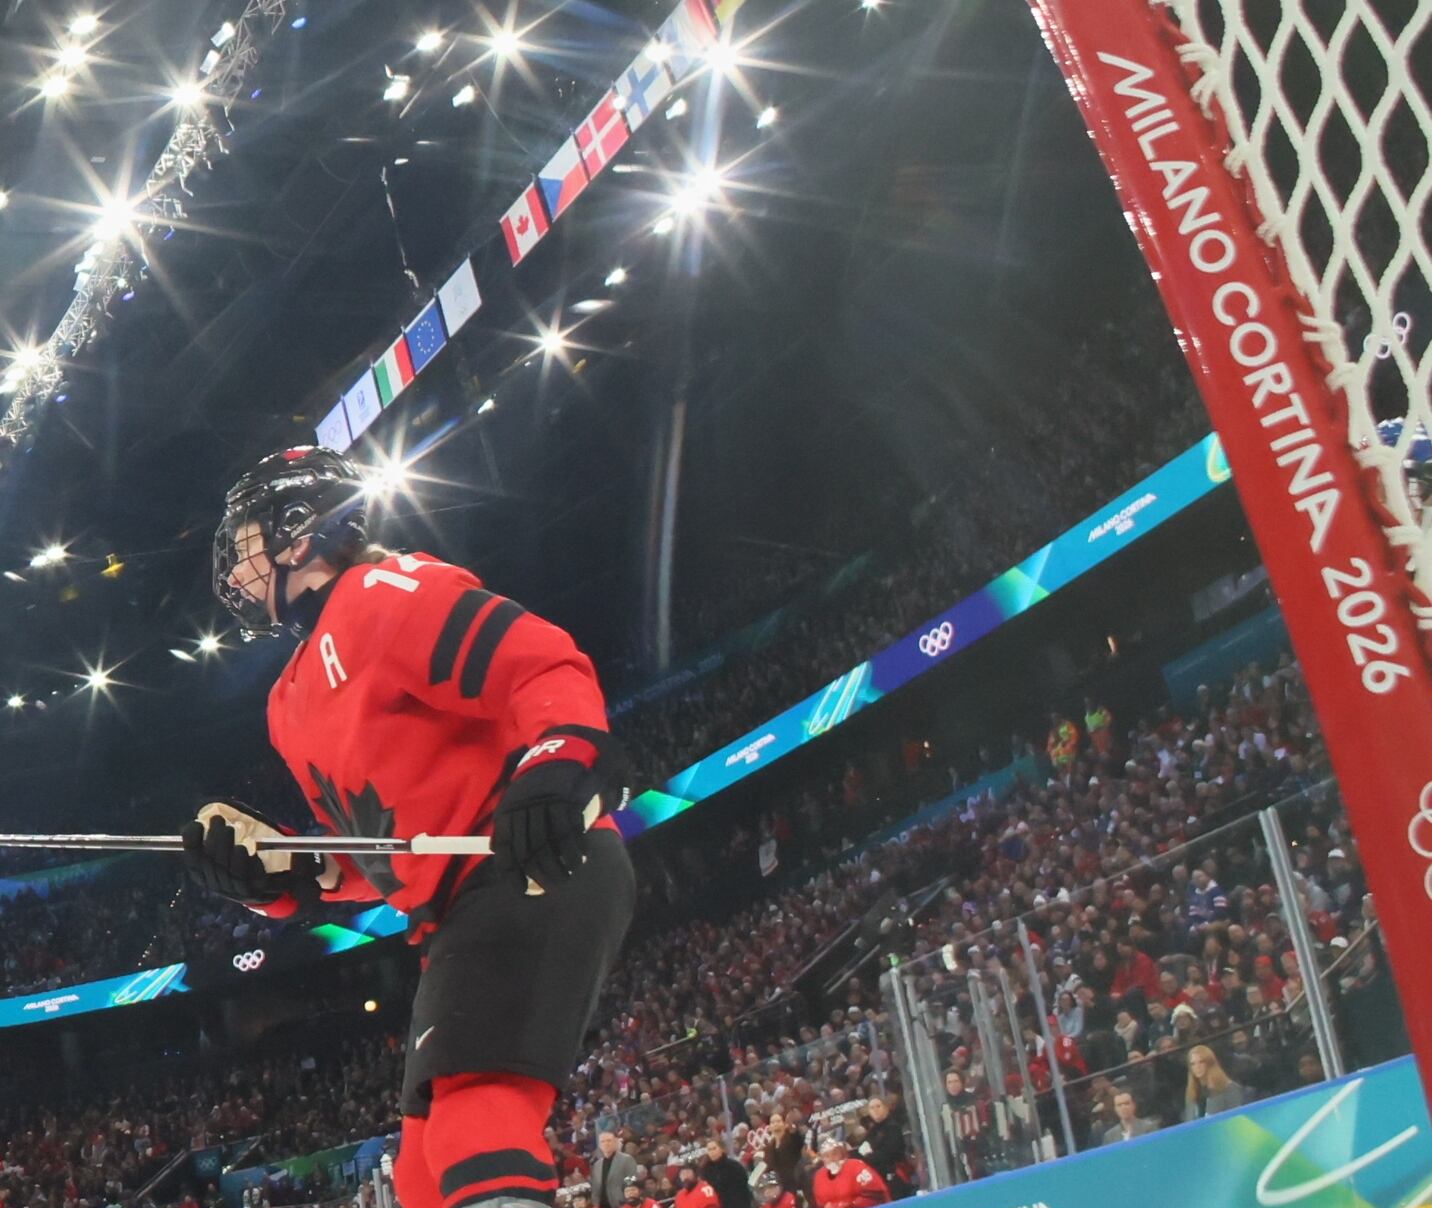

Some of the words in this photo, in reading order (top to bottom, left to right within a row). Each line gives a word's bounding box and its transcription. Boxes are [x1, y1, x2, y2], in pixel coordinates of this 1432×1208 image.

[1097, 51, 1235, 275] MILANO
[1211, 281, 1342, 554] CORTINA
[1321, 556, 1411, 695] 2026
[319, 632, 348, 689] A
